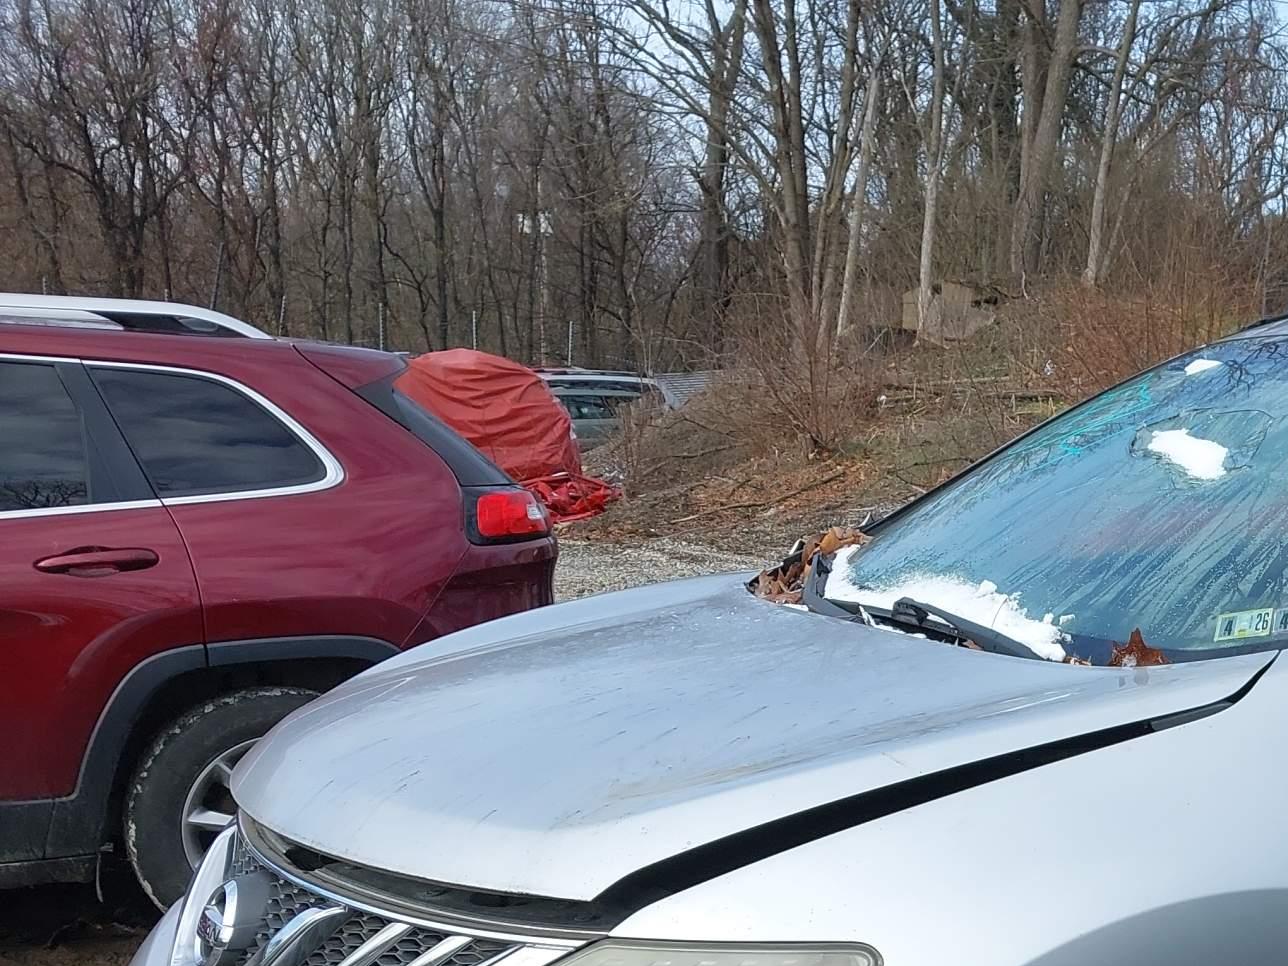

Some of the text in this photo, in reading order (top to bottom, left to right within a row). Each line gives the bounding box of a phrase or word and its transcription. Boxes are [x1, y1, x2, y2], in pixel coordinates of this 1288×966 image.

[1223, 611, 1270, 637] 4 26
[1280, 612, 1288, 630] 4
